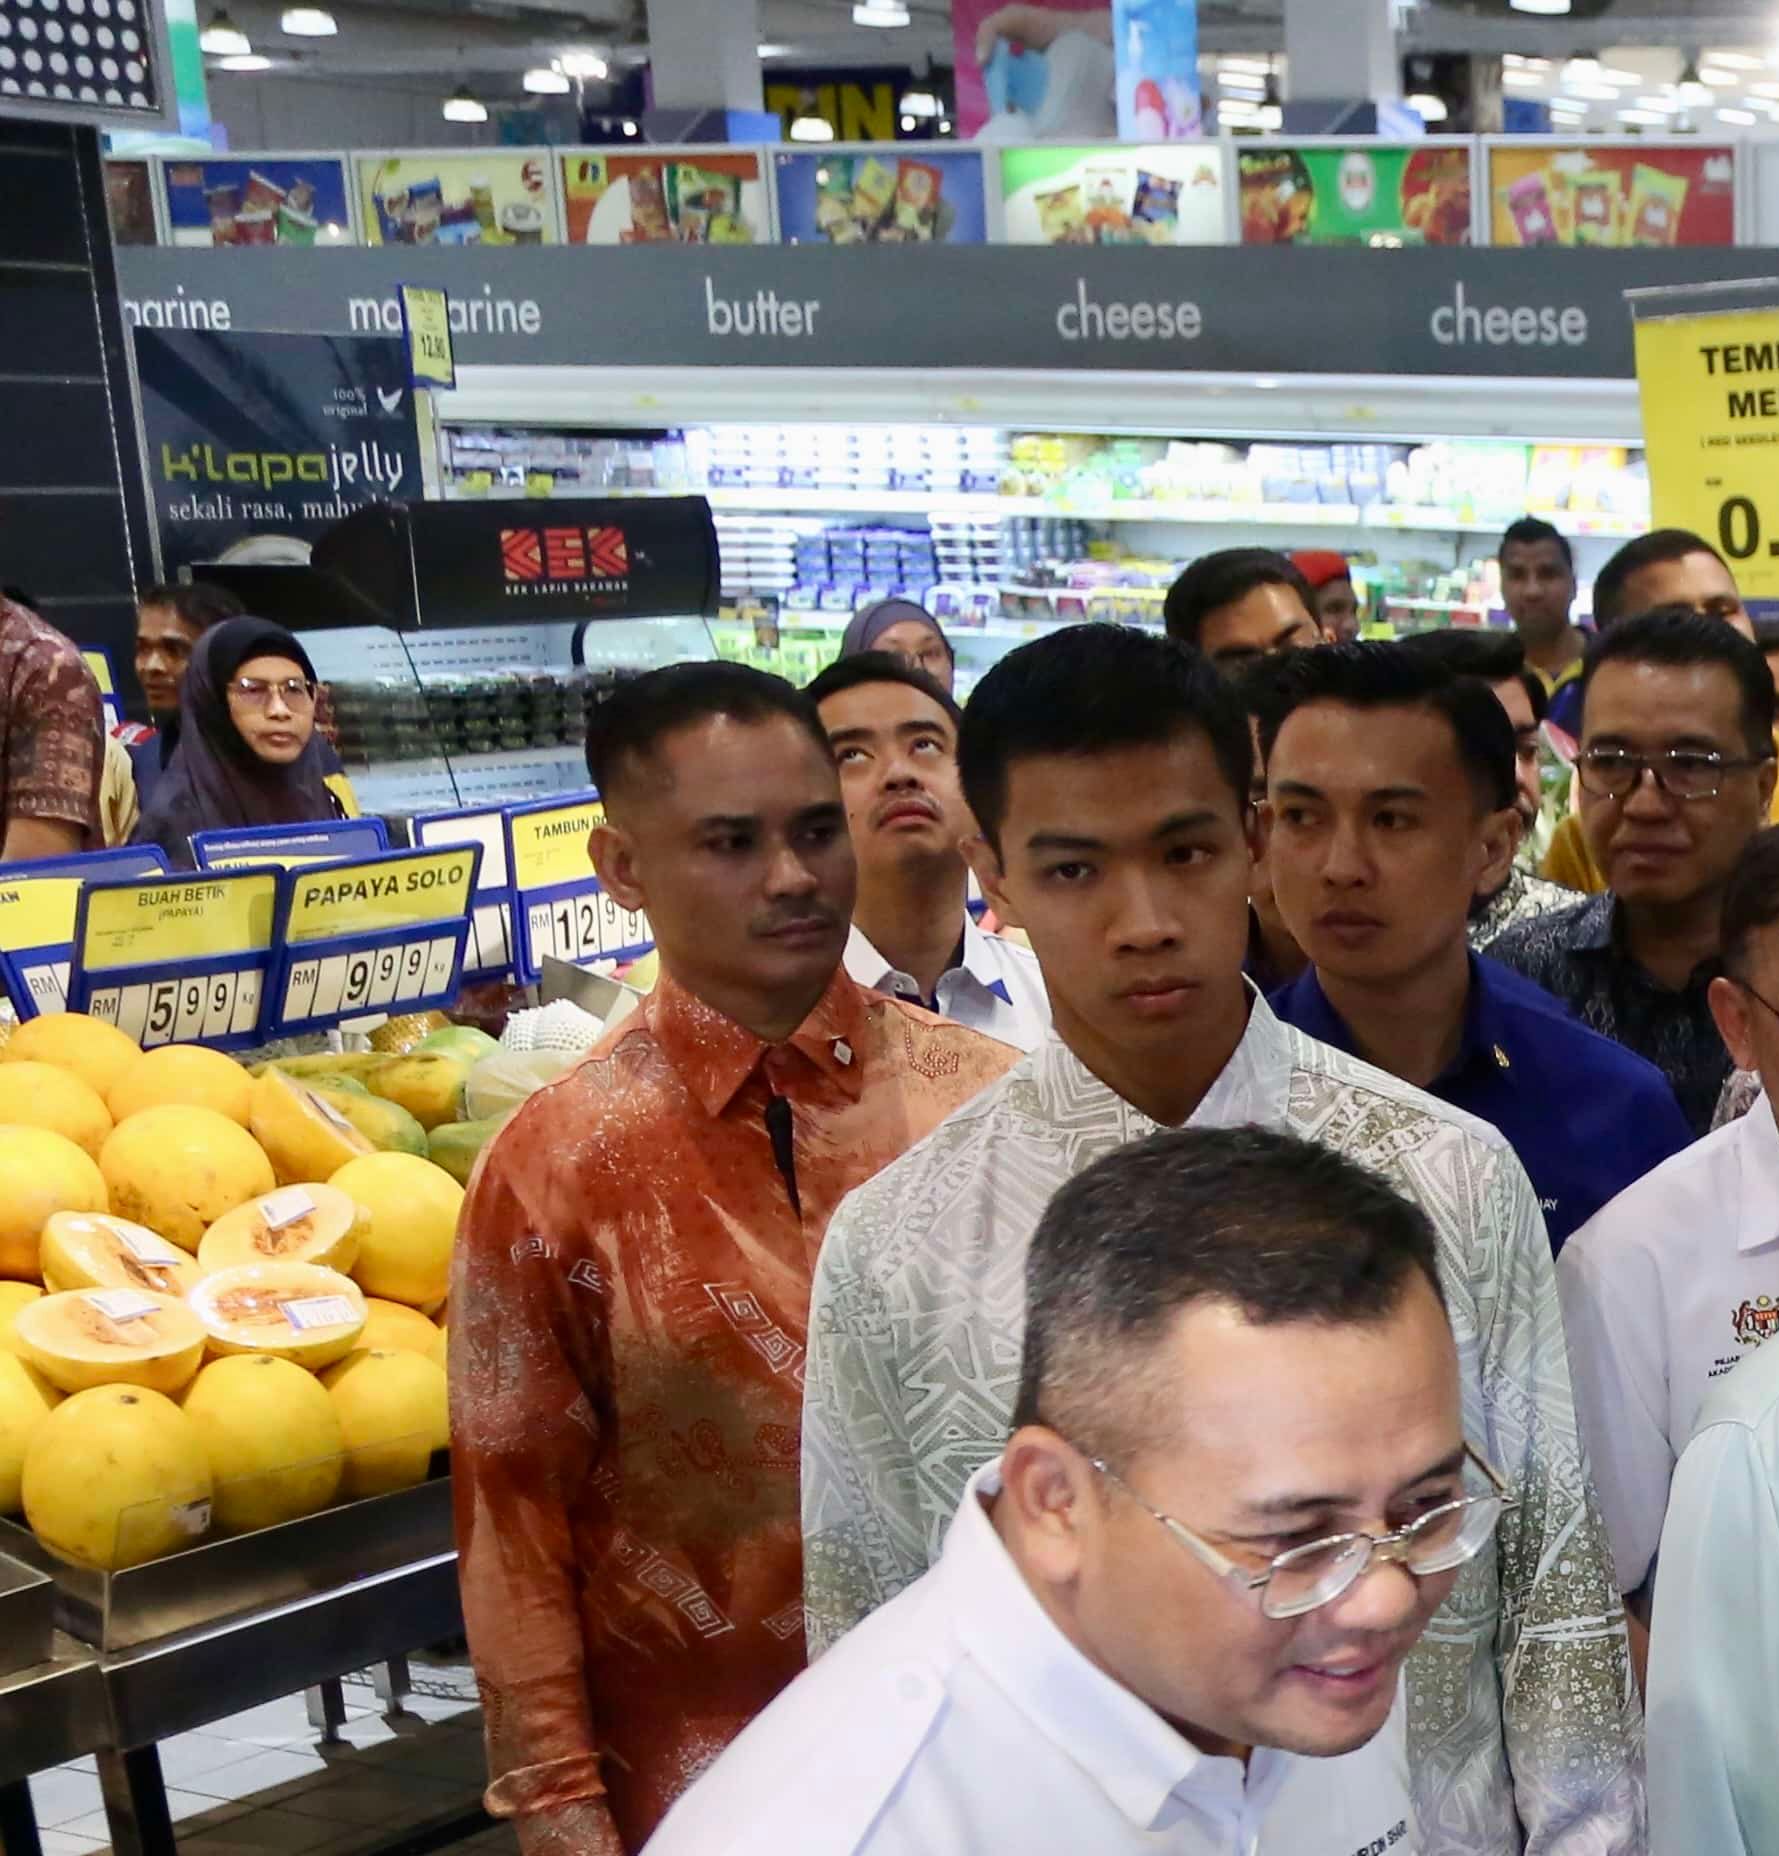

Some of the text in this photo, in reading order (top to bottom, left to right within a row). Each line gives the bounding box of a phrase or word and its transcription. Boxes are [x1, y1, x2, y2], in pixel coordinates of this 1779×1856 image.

[706, 278, 821, 335] butter
[1056, 279, 1201, 340] cheese
[1431, 281, 1588, 345] cheese
[169, 493, 233, 521] sekali
[500, 526, 630, 581] KEK
[534, 816, 590, 841] TAMBUN
[138, 885, 226, 907] BUAH BETIK
[304, 864, 464, 909] PAPAYA SOLO
[531, 911, 550, 929] RM
[30, 977, 58, 995] RM
[292, 967, 316, 988] RM
[92, 997, 117, 1015] RM
